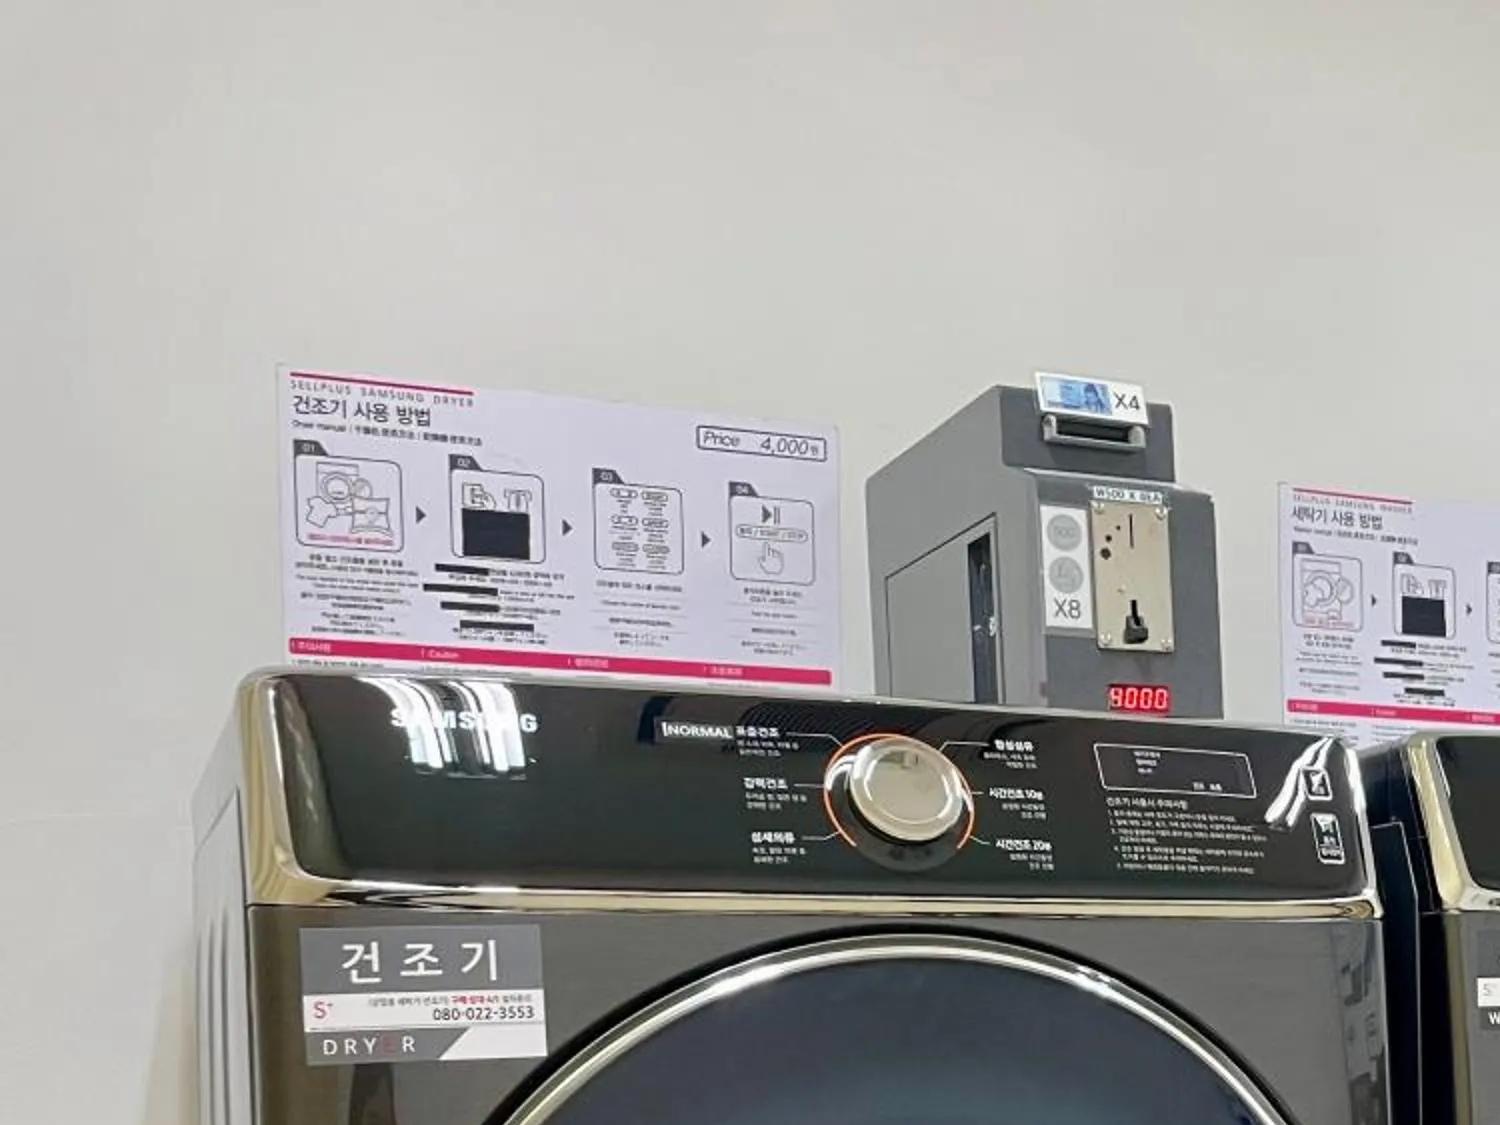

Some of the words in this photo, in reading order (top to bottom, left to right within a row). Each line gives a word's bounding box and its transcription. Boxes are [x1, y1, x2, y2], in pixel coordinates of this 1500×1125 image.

[360, 386, 425, 403] SAMSUNG
[1113, 391, 1141, 411] X4
[293, 395, 348, 419] 건조기
[354, 401, 390, 423] 사용
[397, 406, 432, 428] 방법
[703, 431, 740, 447] Price
[1292, 505, 1328, 525] 세탁기
[1332, 509, 1356, 528] 사용
[1359, 512, 1383, 531] 방법
[1053, 597, 1081, 619] X8
[664, 722, 734, 739] NORMAL
[342, 939, 498, 984] 건조기
[432, 1005, 535, 1021] 080-022-3553
[322, 1035, 417, 1057] DRYER
